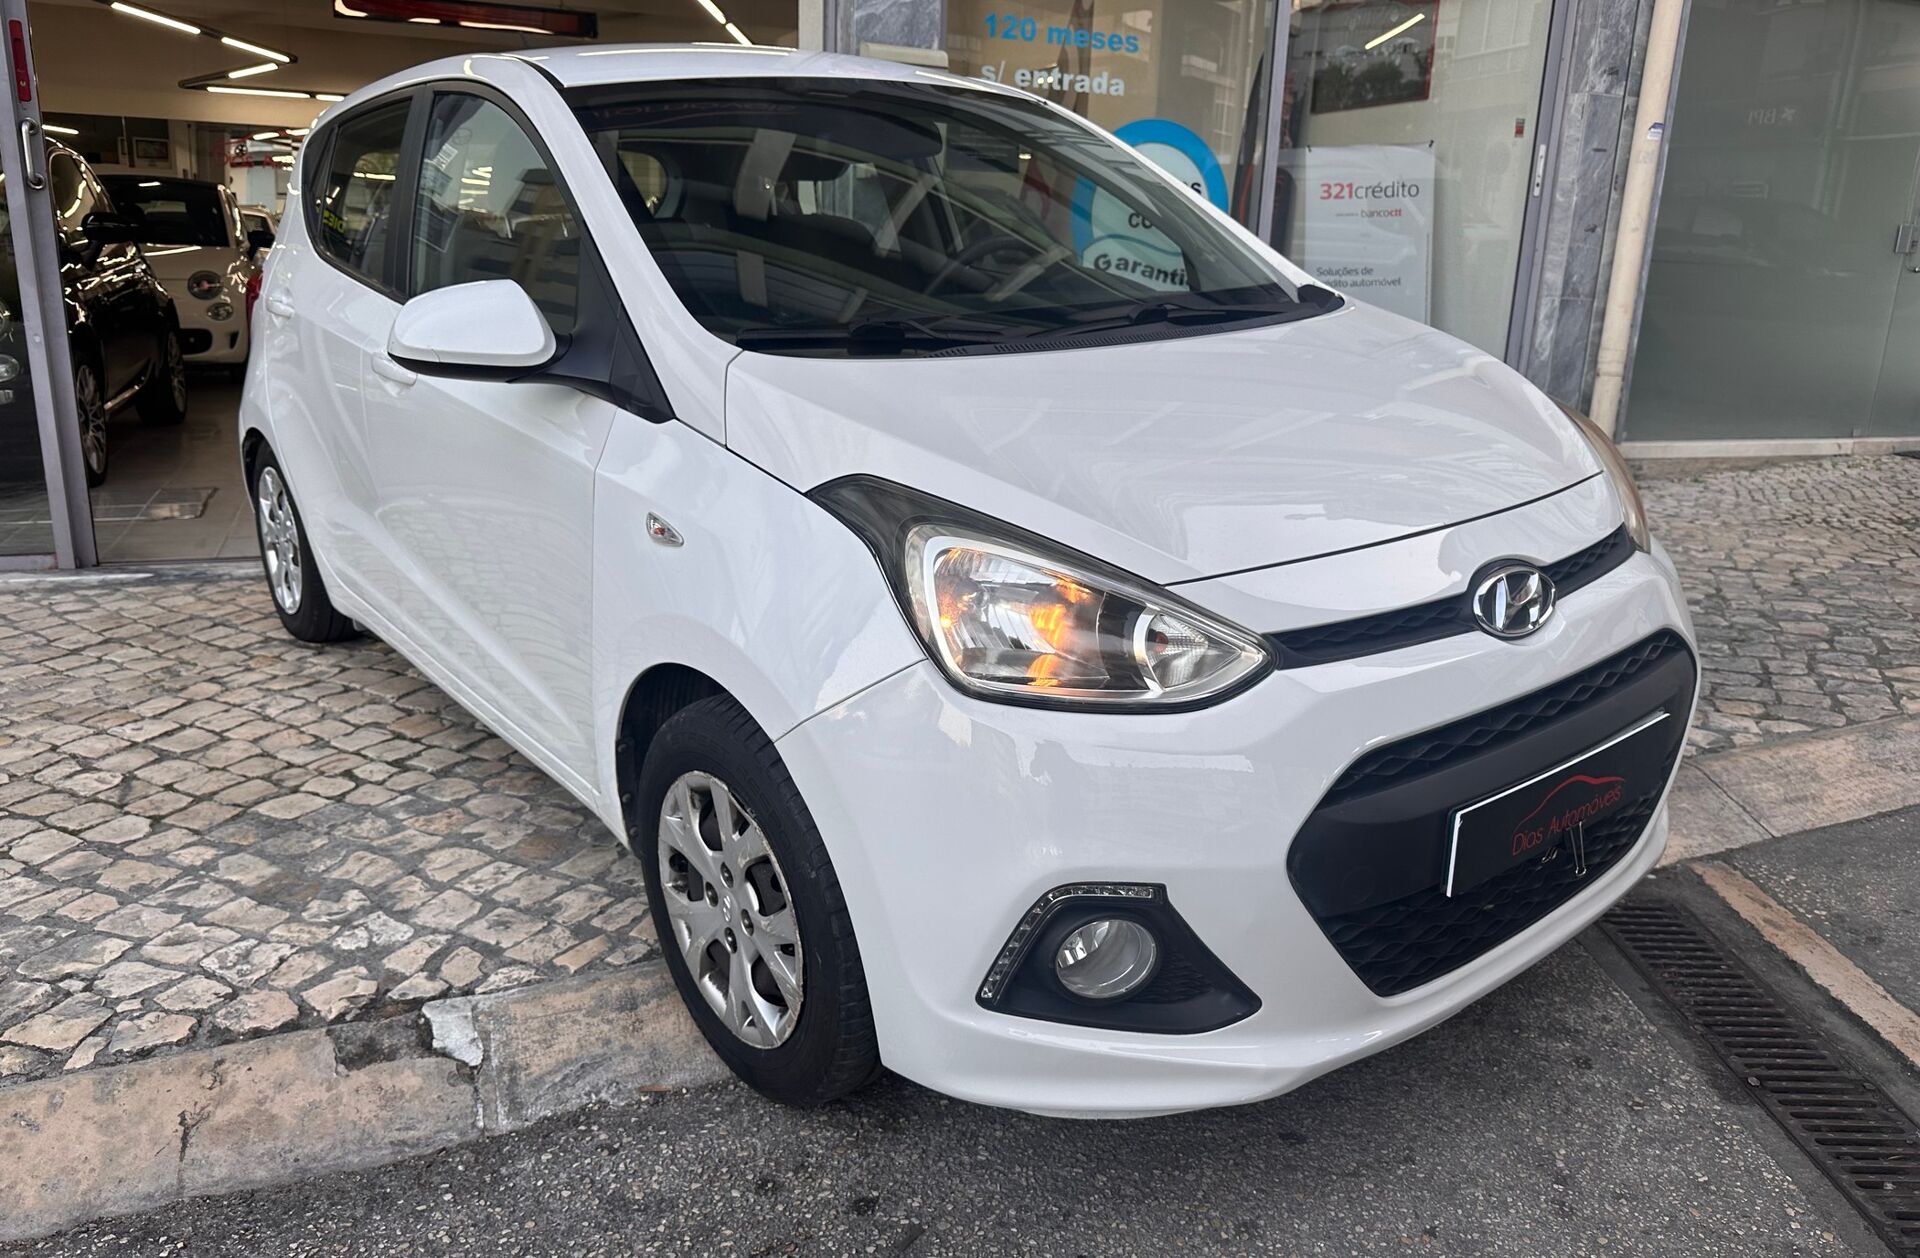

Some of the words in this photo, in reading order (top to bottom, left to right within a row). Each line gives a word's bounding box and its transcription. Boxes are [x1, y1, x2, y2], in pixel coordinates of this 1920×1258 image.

[984, 12, 1037, 42] 120
[1047, 25, 1139, 53] meses
[1014, 67, 1126, 96] entrada
[1320, 181, 1420, 200] 321crédito
[1093, 253, 1190, 287] Garanti
[1361, 266, 1374, 276] de
[1512, 828, 1544, 856] Dias
